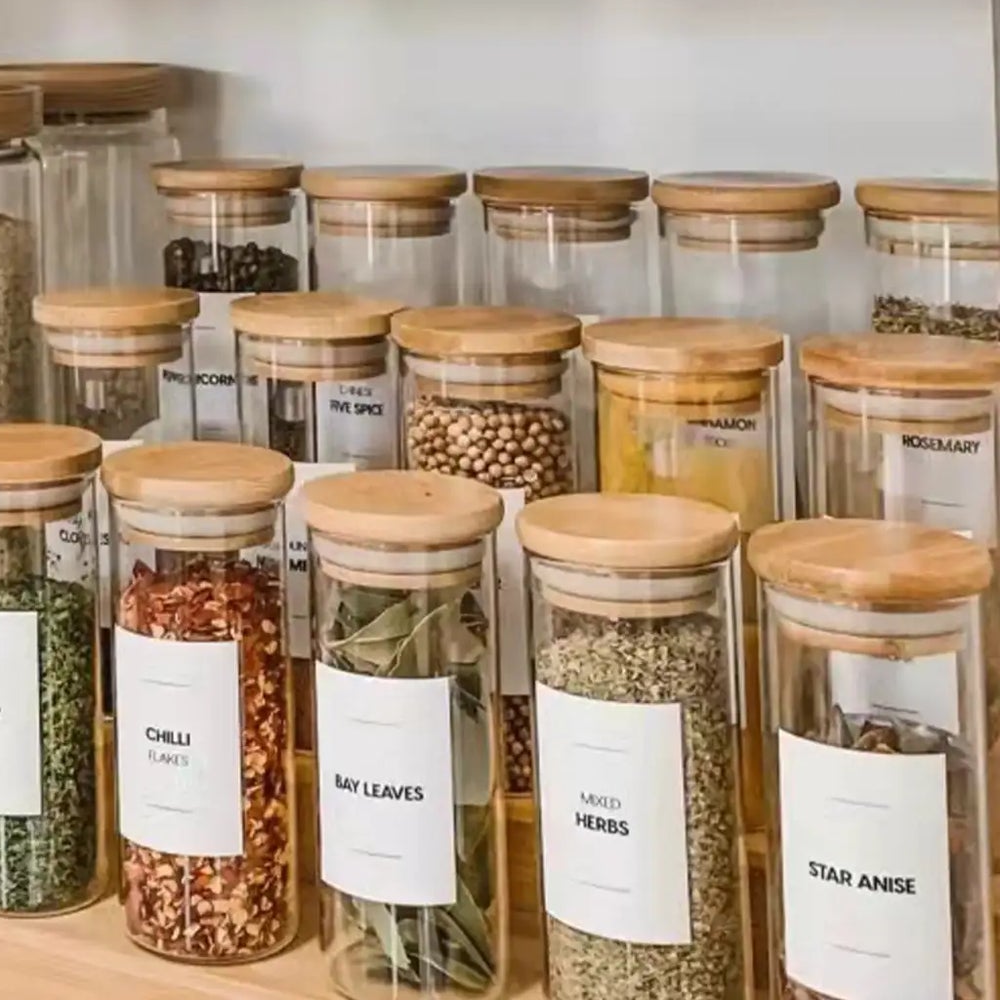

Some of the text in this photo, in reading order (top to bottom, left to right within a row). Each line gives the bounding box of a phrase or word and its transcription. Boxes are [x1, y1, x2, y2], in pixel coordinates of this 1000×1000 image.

[902, 434, 980, 453] ROSEMARY
[145, 727, 190, 746] CHILLI
[335, 773, 424, 801] BAY LEAVES
[575, 812, 629, 836] HERBS
[809, 861, 916, 895] STAR ANISE
